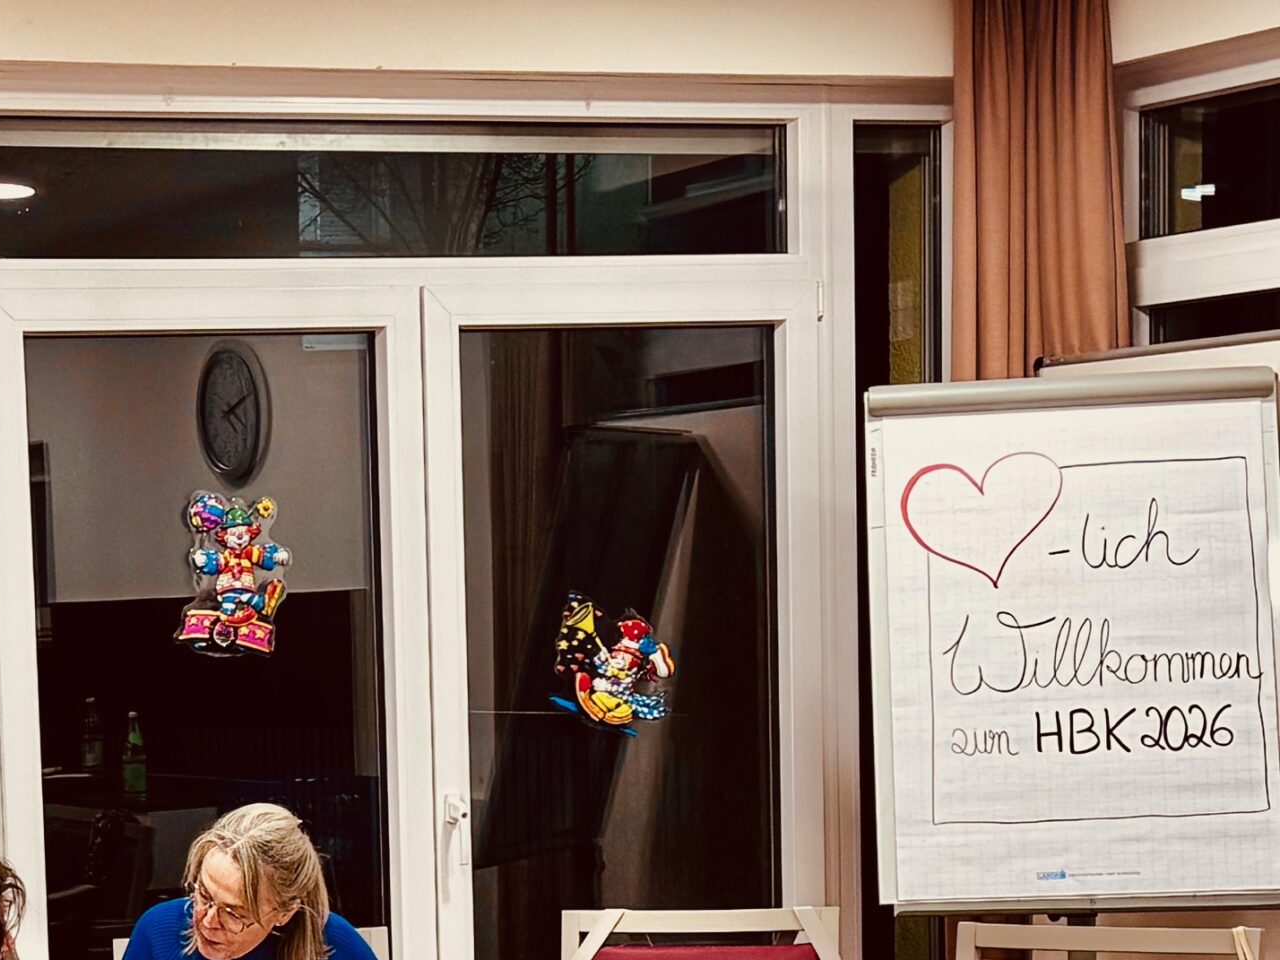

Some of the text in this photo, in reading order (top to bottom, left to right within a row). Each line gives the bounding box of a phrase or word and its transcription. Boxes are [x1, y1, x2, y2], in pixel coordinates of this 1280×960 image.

[942, 610, 1264, 696] Willkommen
[950, 703, 1235, 757] zum HBK 2026
